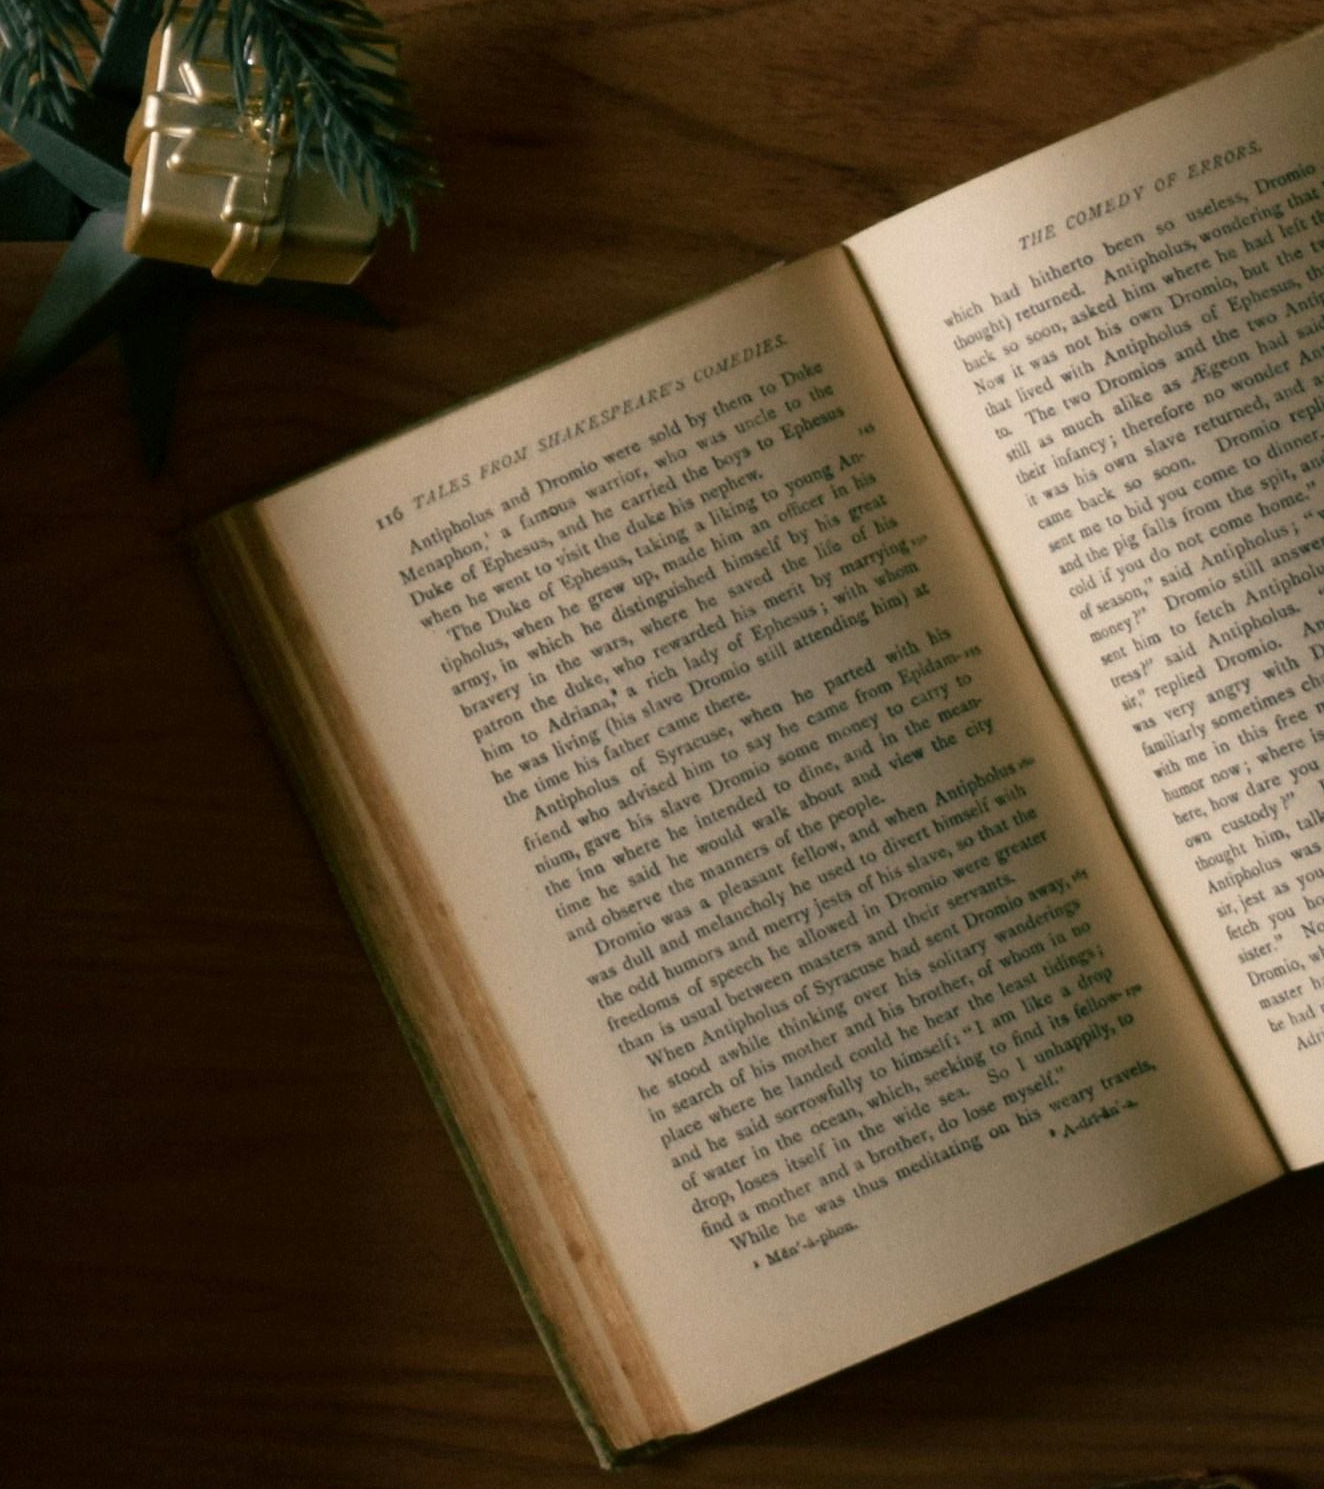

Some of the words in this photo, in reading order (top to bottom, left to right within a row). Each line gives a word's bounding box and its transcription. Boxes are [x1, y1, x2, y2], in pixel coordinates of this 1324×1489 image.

[943, 302, 984, 328] which
[989, 282, 1021, 307] had
[1028, 254, 1095, 289] hitherto
[1101, 232, 1146, 258] been
[1154, 219, 1176, 236] so
[1184, 191, 1251, 223] useless,
[1252, 162, 1318, 197] Dromio
[1018, 223, 1057, 251] THE
[1065, 184, 1145, 231] COMEDY
[1153, 171, 1178, 193] OF
[984, 397, 1013, 418] that
[1015, 375, 1055, 404] lived
[1059, 360, 1096, 383] with
[1104, 319, 1193, 367] Antipholus
[1200, 303, 1220, 325] of
[1225, 277, 1303, 314] Ephesus,
[1005, 440, 1032, 463] still
[1039, 434, 1055, 449] as
[1060, 409, 1106, 439] much
[1112, 391, 1154, 417] alike
[1161, 378, 1183, 396] as
[1254, 329, 1290, 356] had
[375, 505, 405, 531] 116
[412, 473, 472, 510] TALES
[479, 445, 528, 480] FROM
[409, 507, 495, 556] Antipholus
[500, 486, 531, 513] and
[535, 460, 600, 496] Dromio
[602, 441, 643, 465] were
[647, 418, 684, 446] sold
[683, 411, 708, 429] by
[711, 392, 755, 418] them
[757, 382, 778, 398] to
[778, 362, 824, 388] Duke
[1048, 532, 1077, 554] sent
[1078, 522, 1103, 540] me
[1105, 513, 1124, 528] to
[1123, 495, 1155, 519] bid
[1156, 485, 1189, 512] you
[1192, 464, 1239, 491] come
[1241, 454, 1263, 471] to
[1265, 429, 1319, 460] dinner.
[445, 620, 483, 643] The
[485, 598, 533, 626] Duke
[537, 580, 556, 602] of
[558, 555, 634, 592] Ephesus,
[633, 527, 691, 559] taking
[707, 496, 760, 527] liking
[759, 488, 780, 504] to
[783, 463, 836, 499] young
[838, 452, 866, 473] An-
[451, 669, 498, 697] army,
[498, 658, 520, 674] in
[526, 630, 576, 661] which
[578, 619, 604, 637] he
[610, 564, 718, 624] distinguished
[720, 534, 783, 574] himself
[785, 527, 810, 546] by
[813, 513, 842, 534] his
[847, 493, 889, 524] great
[1068, 574, 1098, 598] cold
[1101, 566, 1113, 584] if
[1116, 558, 1146, 583] you
[1149, 546, 1172, 564] do
[1175, 531, 1205, 553] not
[1208, 512, 1255, 539] come
[534, 774, 621, 823] Antipholus
[629, 756, 648, 778] of
[654, 725, 735, 766] Syracuse,
[738, 701, 785, 727] when
[789, 688, 815, 706] he
[822, 656, 878, 697] parted
[883, 639, 922, 665] with
[924, 626, 953, 647] his
[1131, 716, 1158, 733] was
[1163, 700, 1196, 721] very
[1205, 676, 1251, 705] angry
[1261, 655, 1301, 680] with
[1141, 722, 1207, 758] familiarly
[1210, 686, 1297, 730] sometimes
[593, 921, 657, 957] Dromio
[659, 905, 694, 927] was
[716, 862, 786, 907] pleasant
[790, 839, 847, 870] fellow,
[847, 817, 882, 845] and
[883, 801, 930, 828] when
[934, 762, 1018, 809] Antipholus
[1172, 807, 1208, 826] here,
[1207, 791, 1240, 812] how
[1245, 775, 1282, 798] dare
[1287, 759, 1321, 784] you
[606, 992, 682, 1033] freedoms
[686, 976, 705, 997] of
[708, 954, 766, 989] speech
[766, 944, 791, 962] he
[796, 909, 860, 950] allowed
[861, 903, 882, 920] in
[883, 874, 949, 910] Dromio
[951, 855, 992, 880] were
[993, 828, 1049, 867] greater
[1207, 858, 1283, 895] Antipholus
[1289, 841, 1323, 861] was
[636, 1084, 660, 1101] he
[666, 1056, 712, 1089] stood
[717, 1034, 771, 1066] awhile
[776, 1000, 849, 1040] thinking
[852, 981, 889, 1007] over
[893, 967, 923, 988] his
[927, 938, 988, 974] solitary
[993, 898, 1082, 944] wanderings
[1246, 959, 1306, 988] Dromio,
[680, 1170, 699, 1192] of
[702, 1154, 747, 1182] water
[750, 1145, 772, 1161] in
[774, 1131, 804, 1151] the
[809, 1107, 865, 1136] ocean,
[865, 1079, 922, 1110] which,
[923, 1050, 988, 1087] seeking
[988, 1041, 1008, 1057] to
[1010, 1020, 1046, 1048] find
[1046, 1012, 1072, 1031] its
[1072, 991, 1124, 1021] fellow-
[728, 1223, 781, 1252] While
[784, 1212, 808, 1229] he
[814, 1194, 847, 1215] was
[851, 1176, 890, 1200] thus
[894, 1134, 985, 1182] meditating
[987, 1122, 1012, 1141] on
[1013, 1108, 1043, 1128] his
[1047, 1084, 1096, 1113] weary
[1098, 1059, 1158, 1091] travels,
